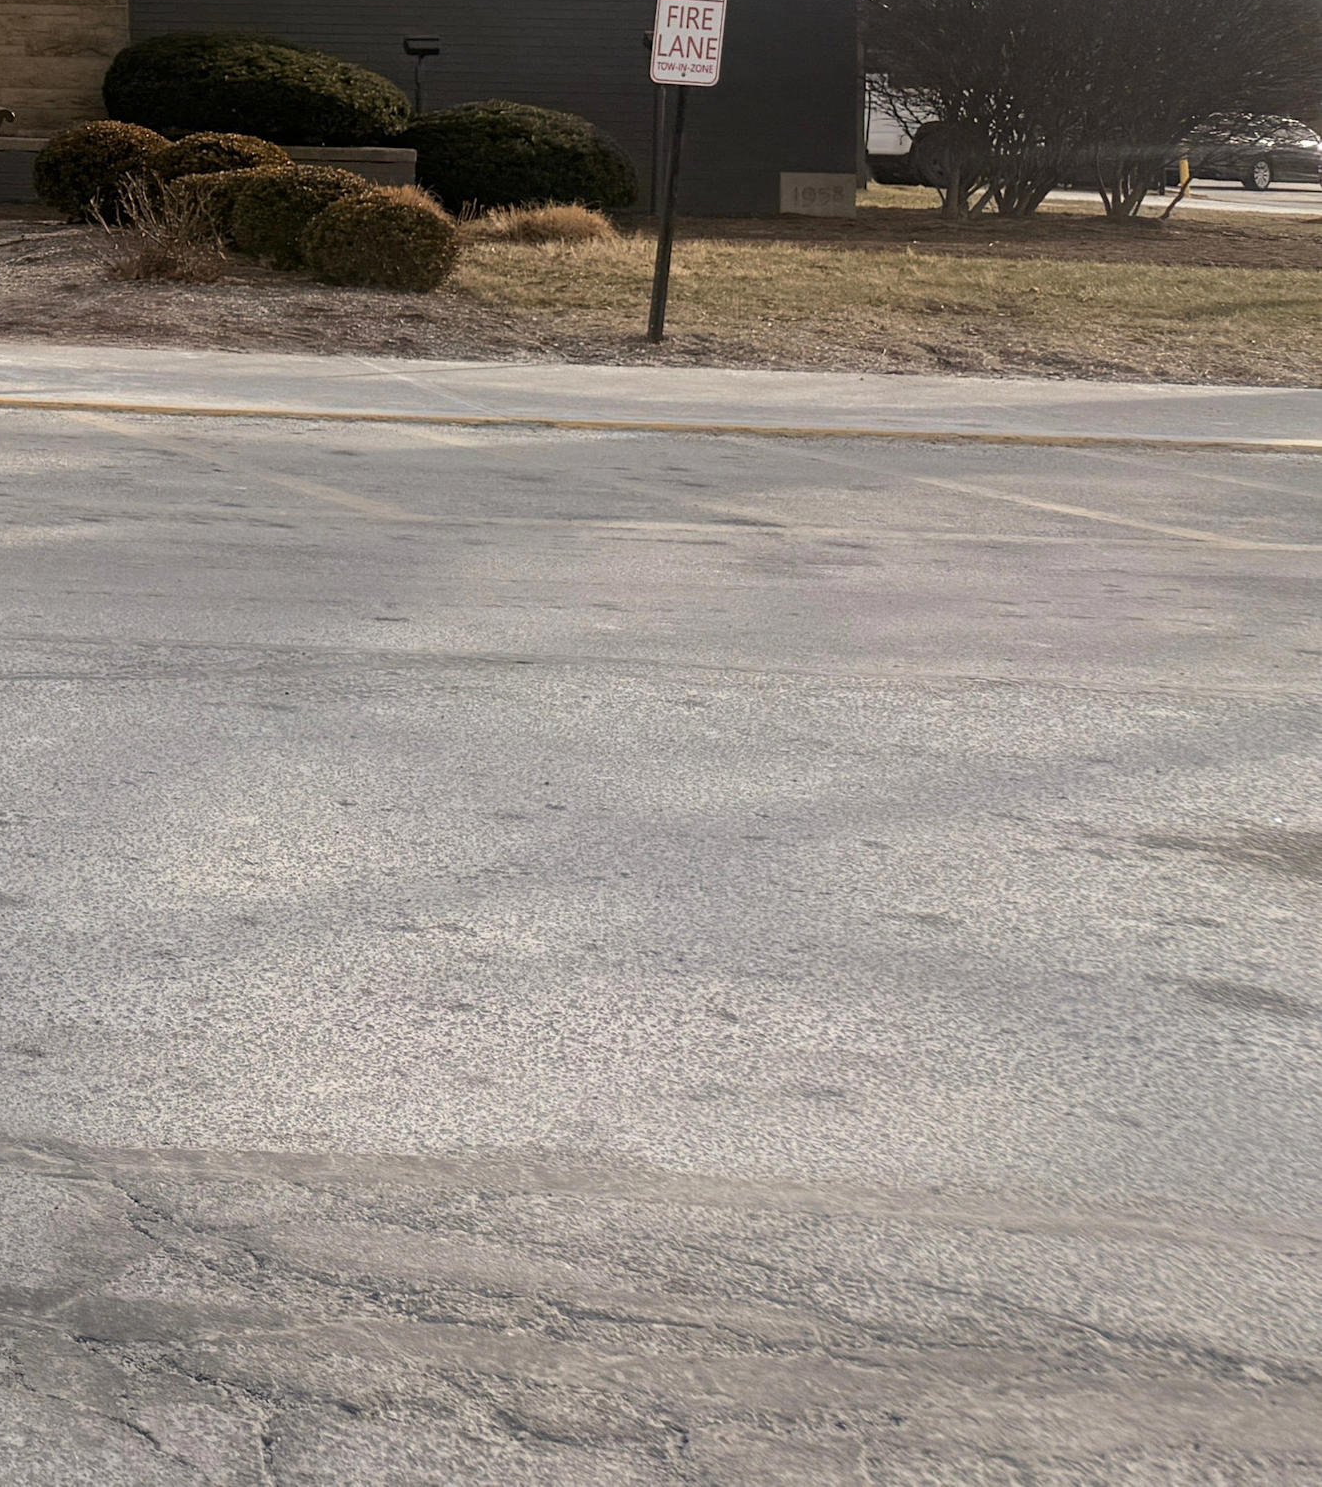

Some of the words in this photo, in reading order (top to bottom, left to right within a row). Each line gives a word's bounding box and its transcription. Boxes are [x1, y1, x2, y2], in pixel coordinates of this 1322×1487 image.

[667, 5, 714, 31] FIRE
[657, 33, 718, 60] LANE
[791, 185, 844, 208] 1958
